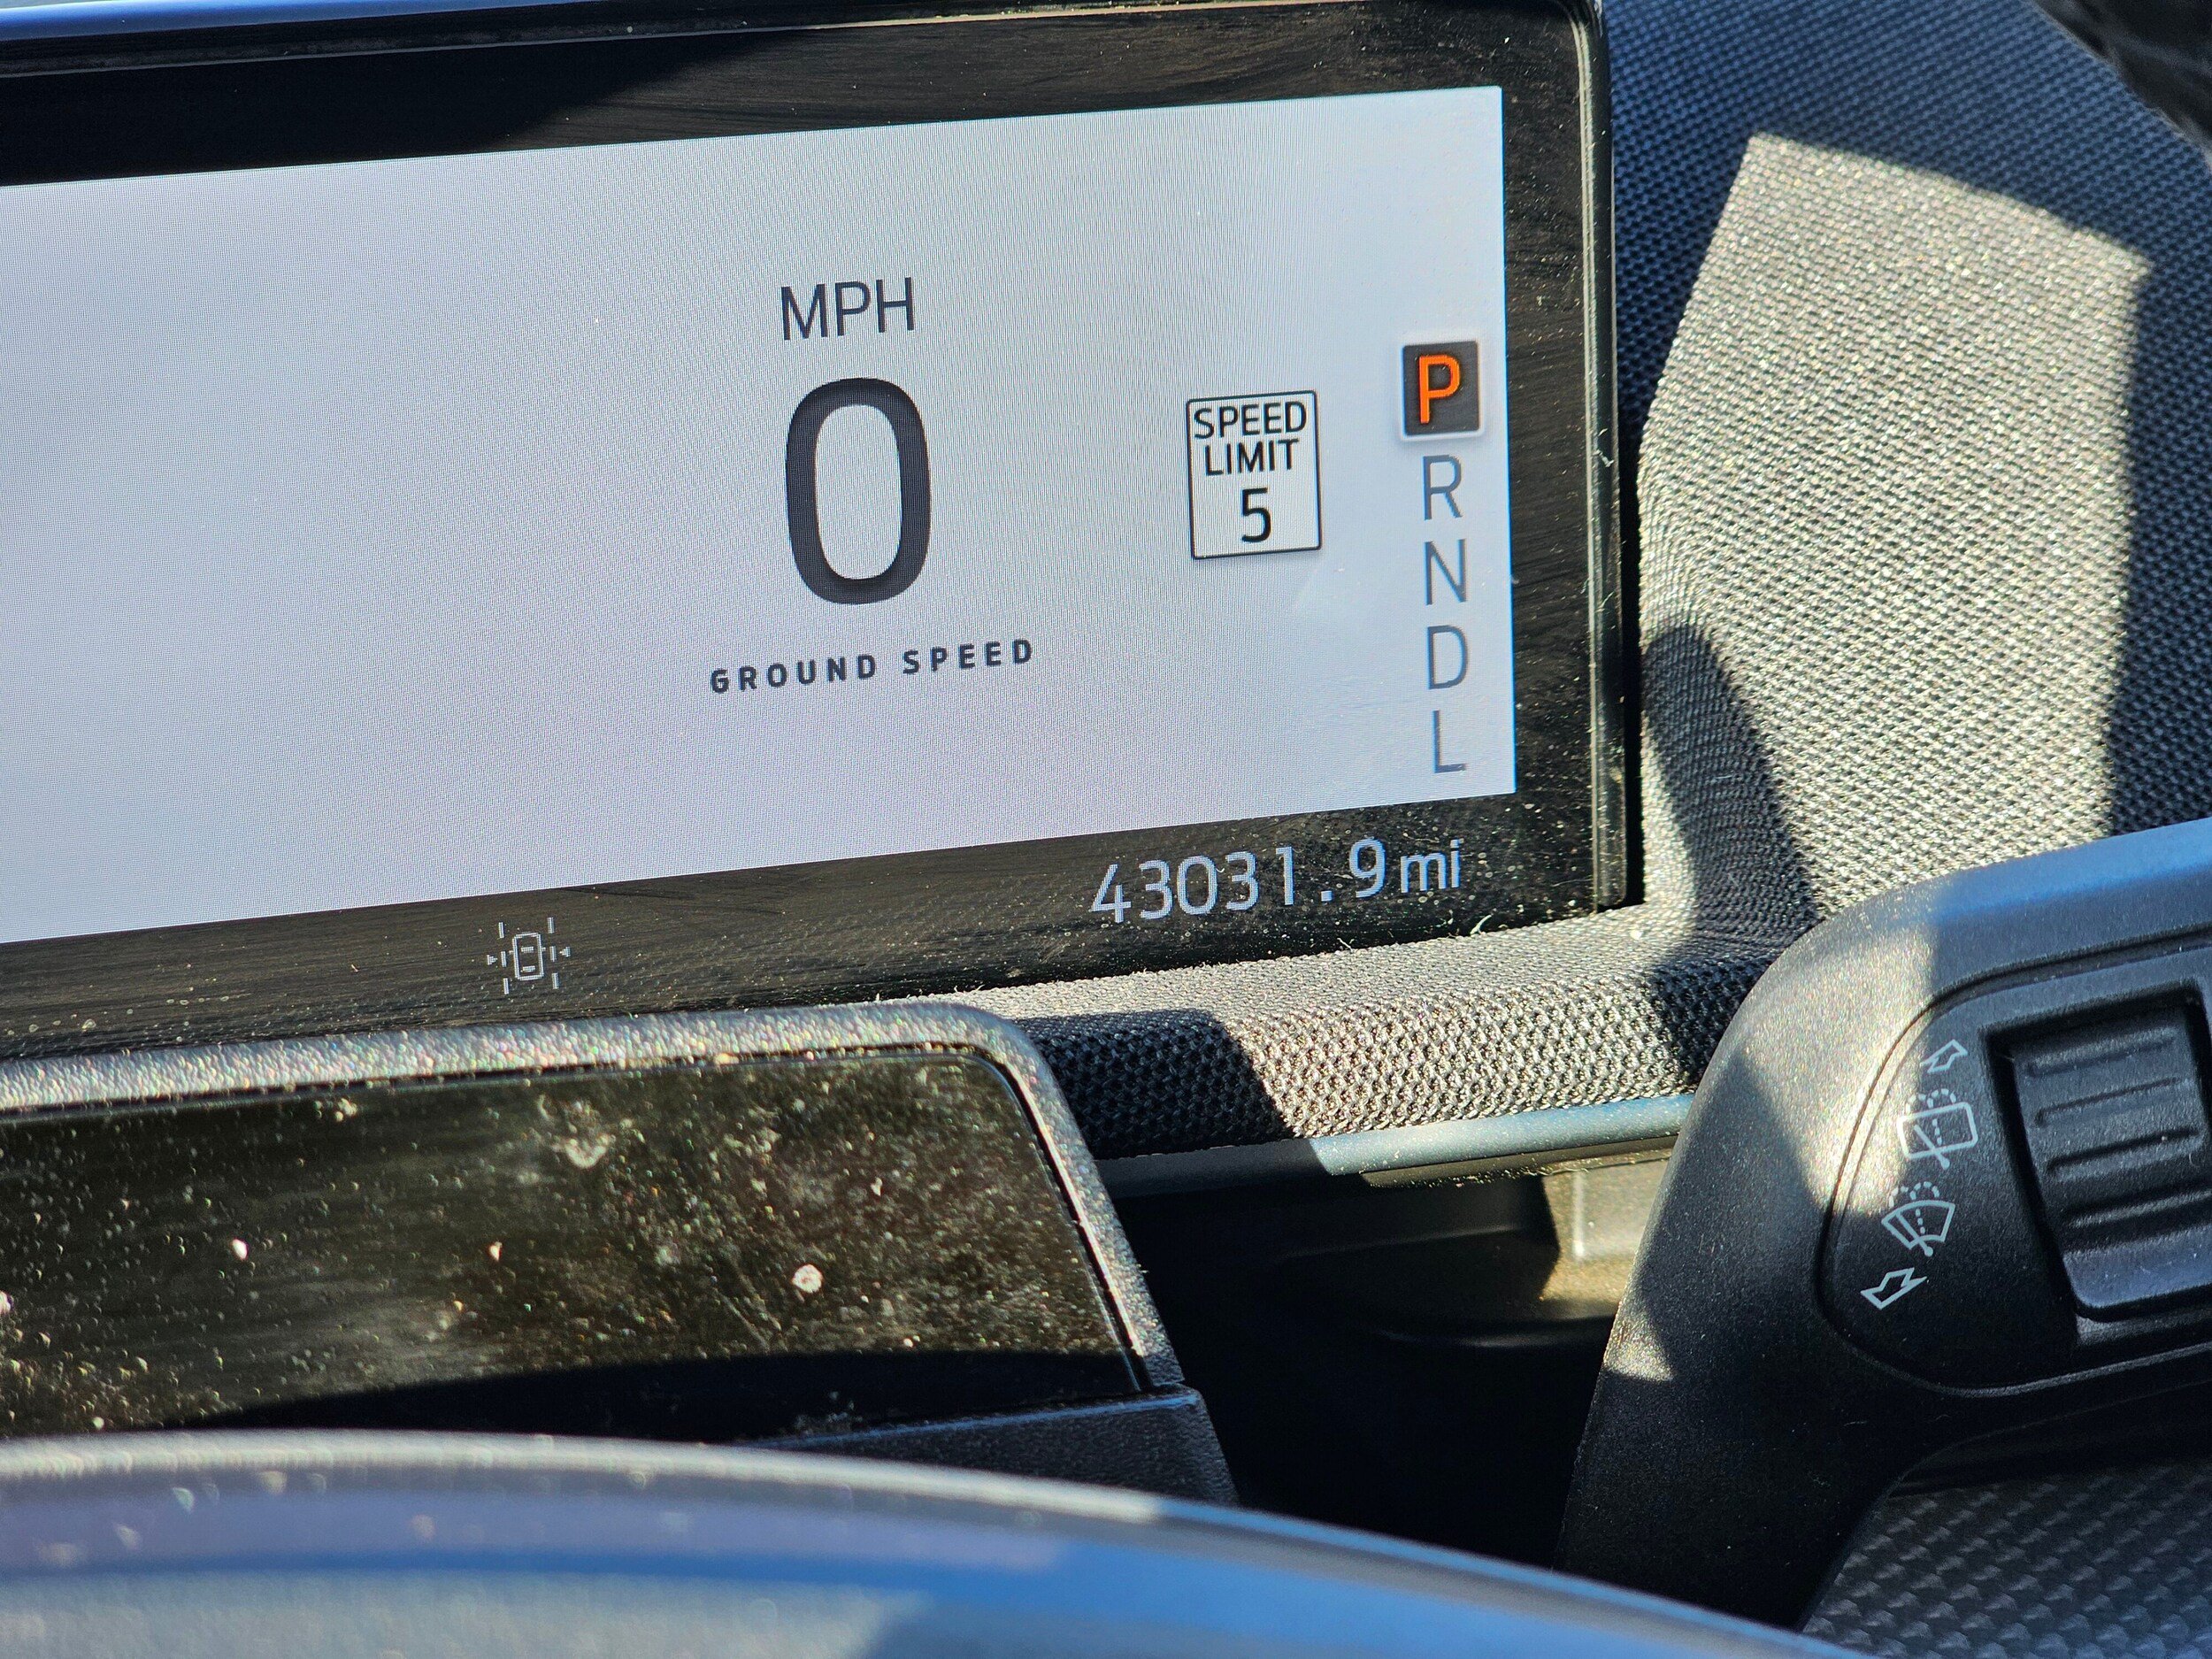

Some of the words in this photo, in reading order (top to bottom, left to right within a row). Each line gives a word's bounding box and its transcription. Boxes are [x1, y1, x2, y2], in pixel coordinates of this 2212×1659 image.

[780, 277, 915, 341] MPH
[1194, 401, 1308, 440] SPEED
[1417, 354, 1461, 425] P
[1204, 439, 1300, 477] LIMIT
[1423, 455, 1463, 520] R
[785, 378, 931, 605] 0
[1240, 487, 1272, 543] 5
[1424, 539, 1467, 606] N
[710, 655, 877, 694] GROUND
[902, 638, 1033, 675] SPEED
[1427, 625, 1469, 691] D
[1432, 710, 1466, 774] L
